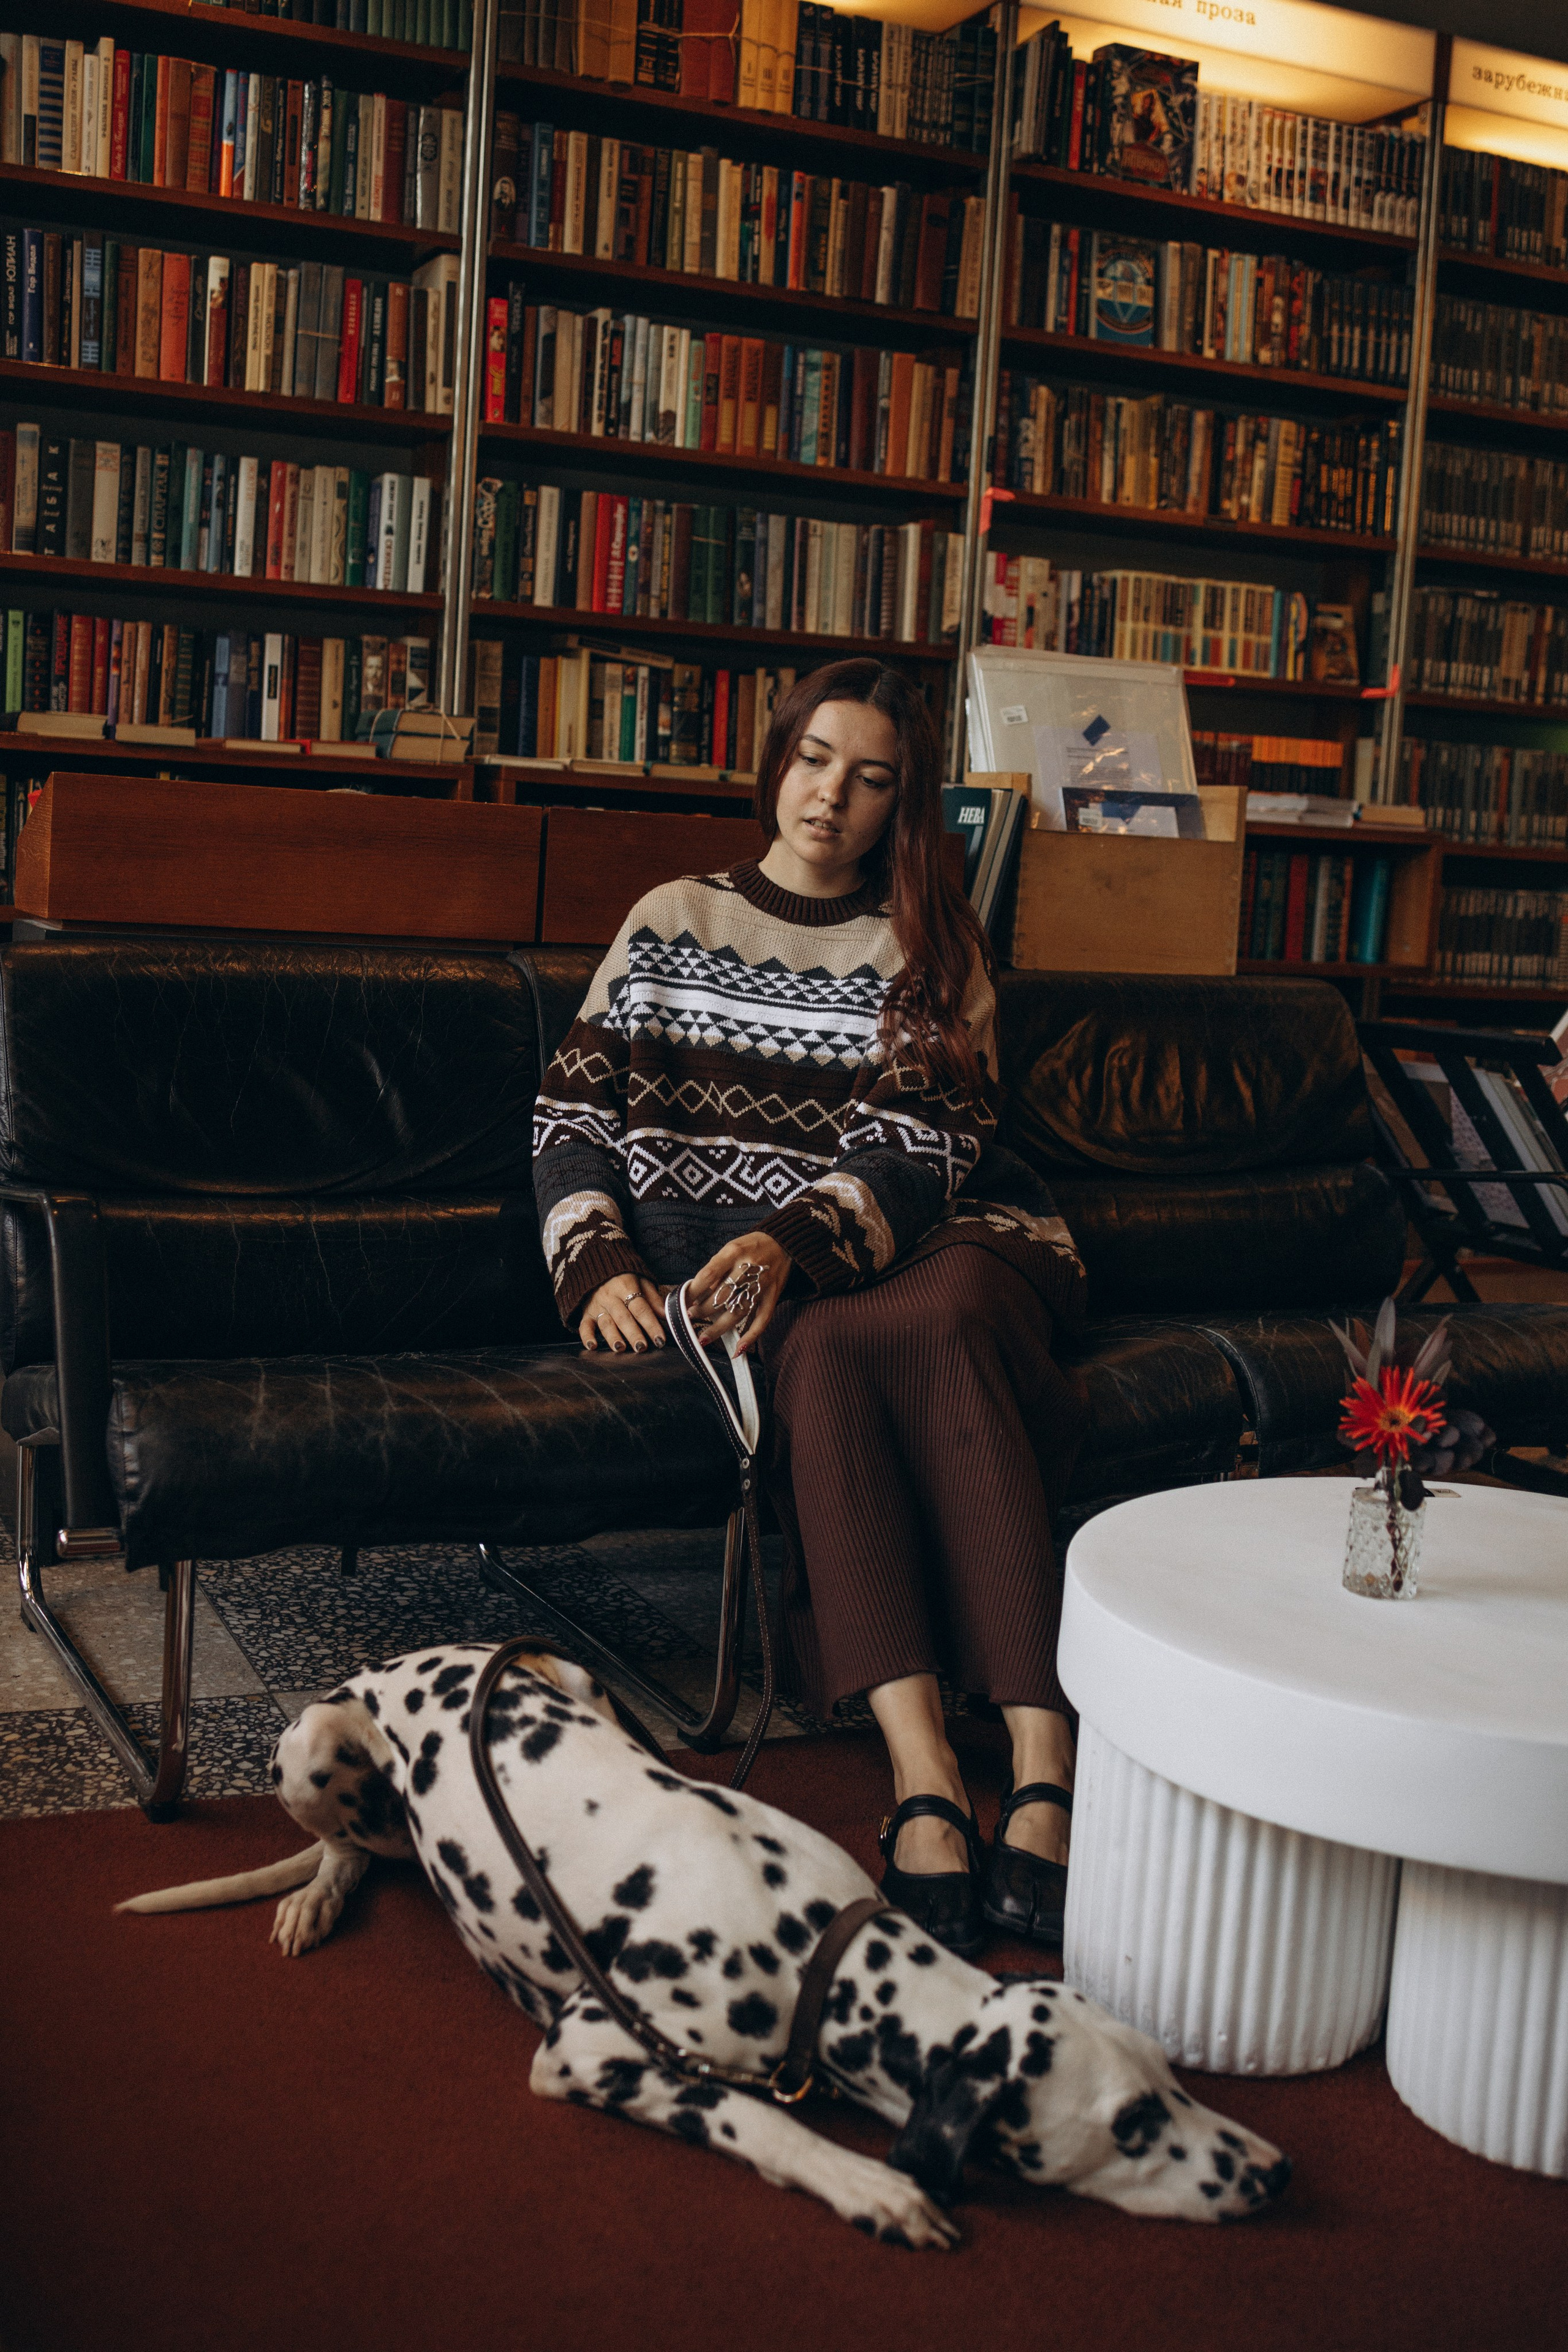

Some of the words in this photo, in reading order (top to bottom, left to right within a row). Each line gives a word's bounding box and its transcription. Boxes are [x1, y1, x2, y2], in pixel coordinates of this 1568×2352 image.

[1196, 1, 1257, 25] проза
[6, 234, 17, 282] ЮЛИАН
[28, 245, 36, 274] Видал
[27, 275, 37, 293] Гор
[154, 468, 168, 530] СПАРТАК
[957, 805, 986, 824] НЕВА
